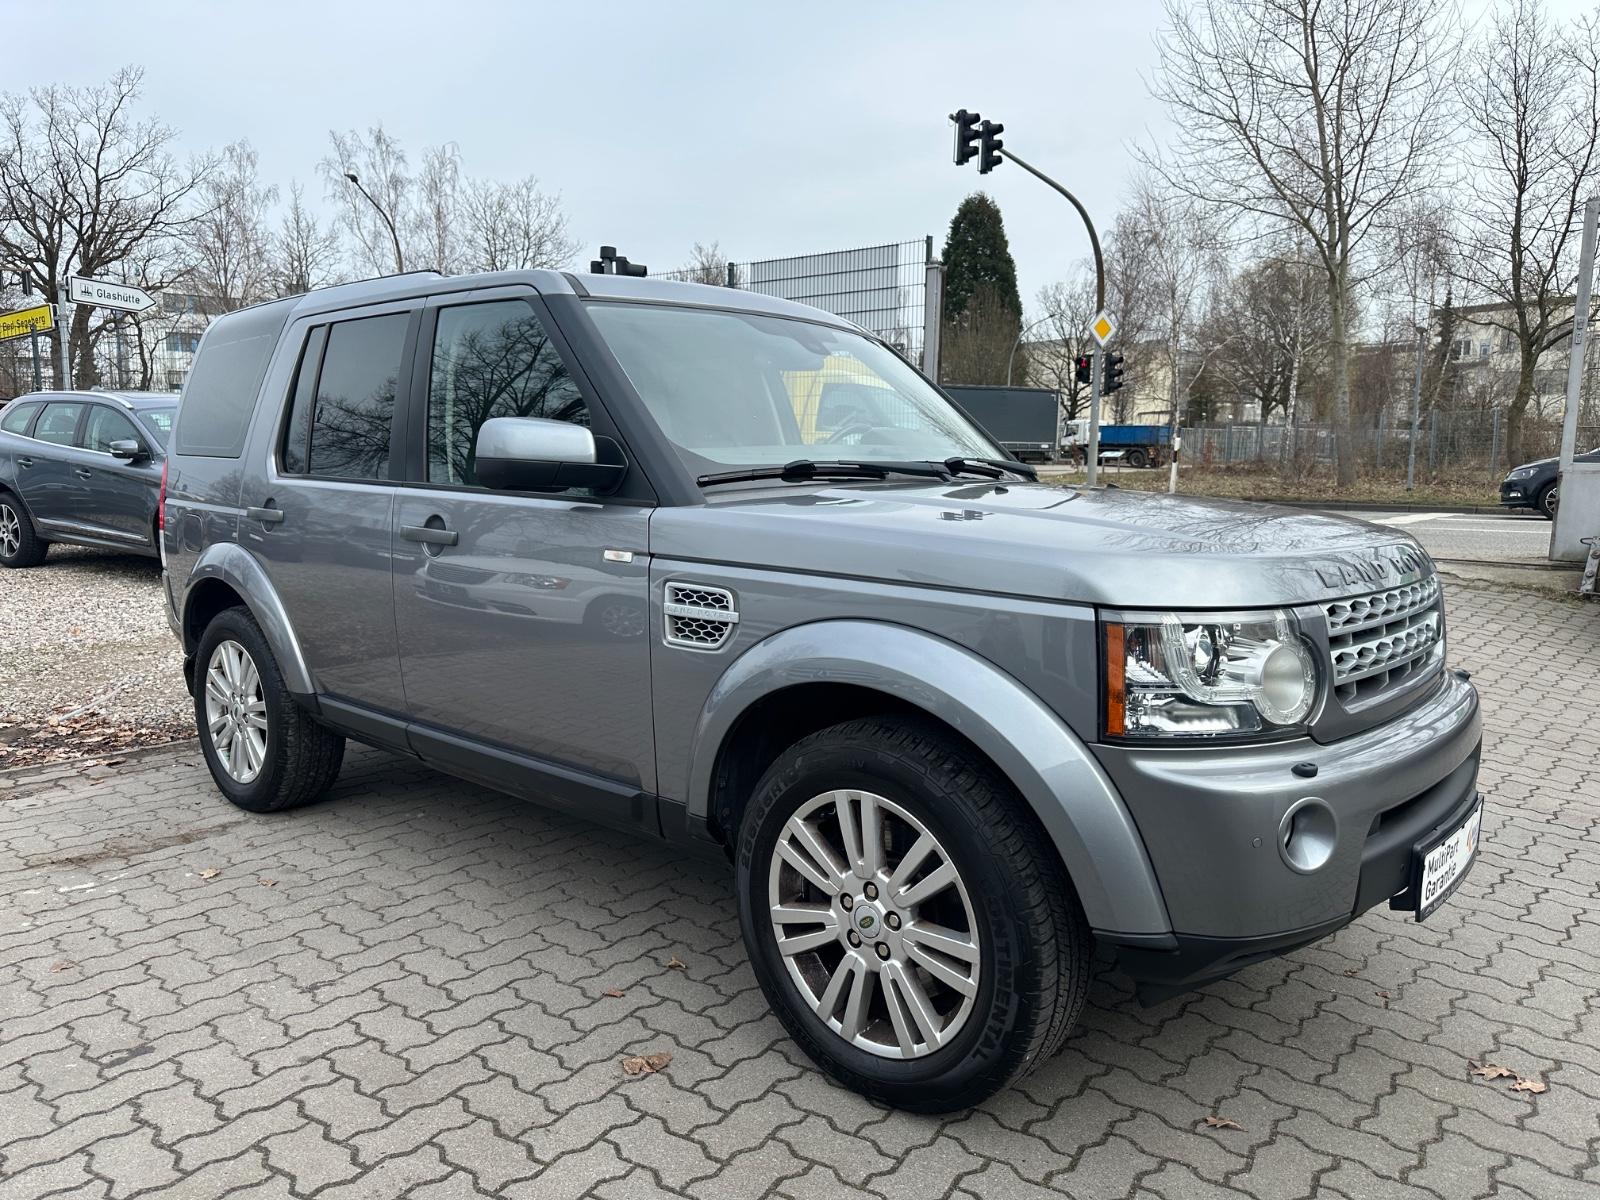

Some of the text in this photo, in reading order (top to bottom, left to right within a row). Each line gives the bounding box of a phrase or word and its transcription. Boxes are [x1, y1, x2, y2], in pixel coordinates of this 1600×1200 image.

[97, 288, 140, 304] Glashütte
[16, 316, 46, 330] Segeberg
[1315, 561, 1388, 588] LAND
[1427, 838, 1459, 878] MultiPart
[1425, 861, 1457, 901] Garantie
